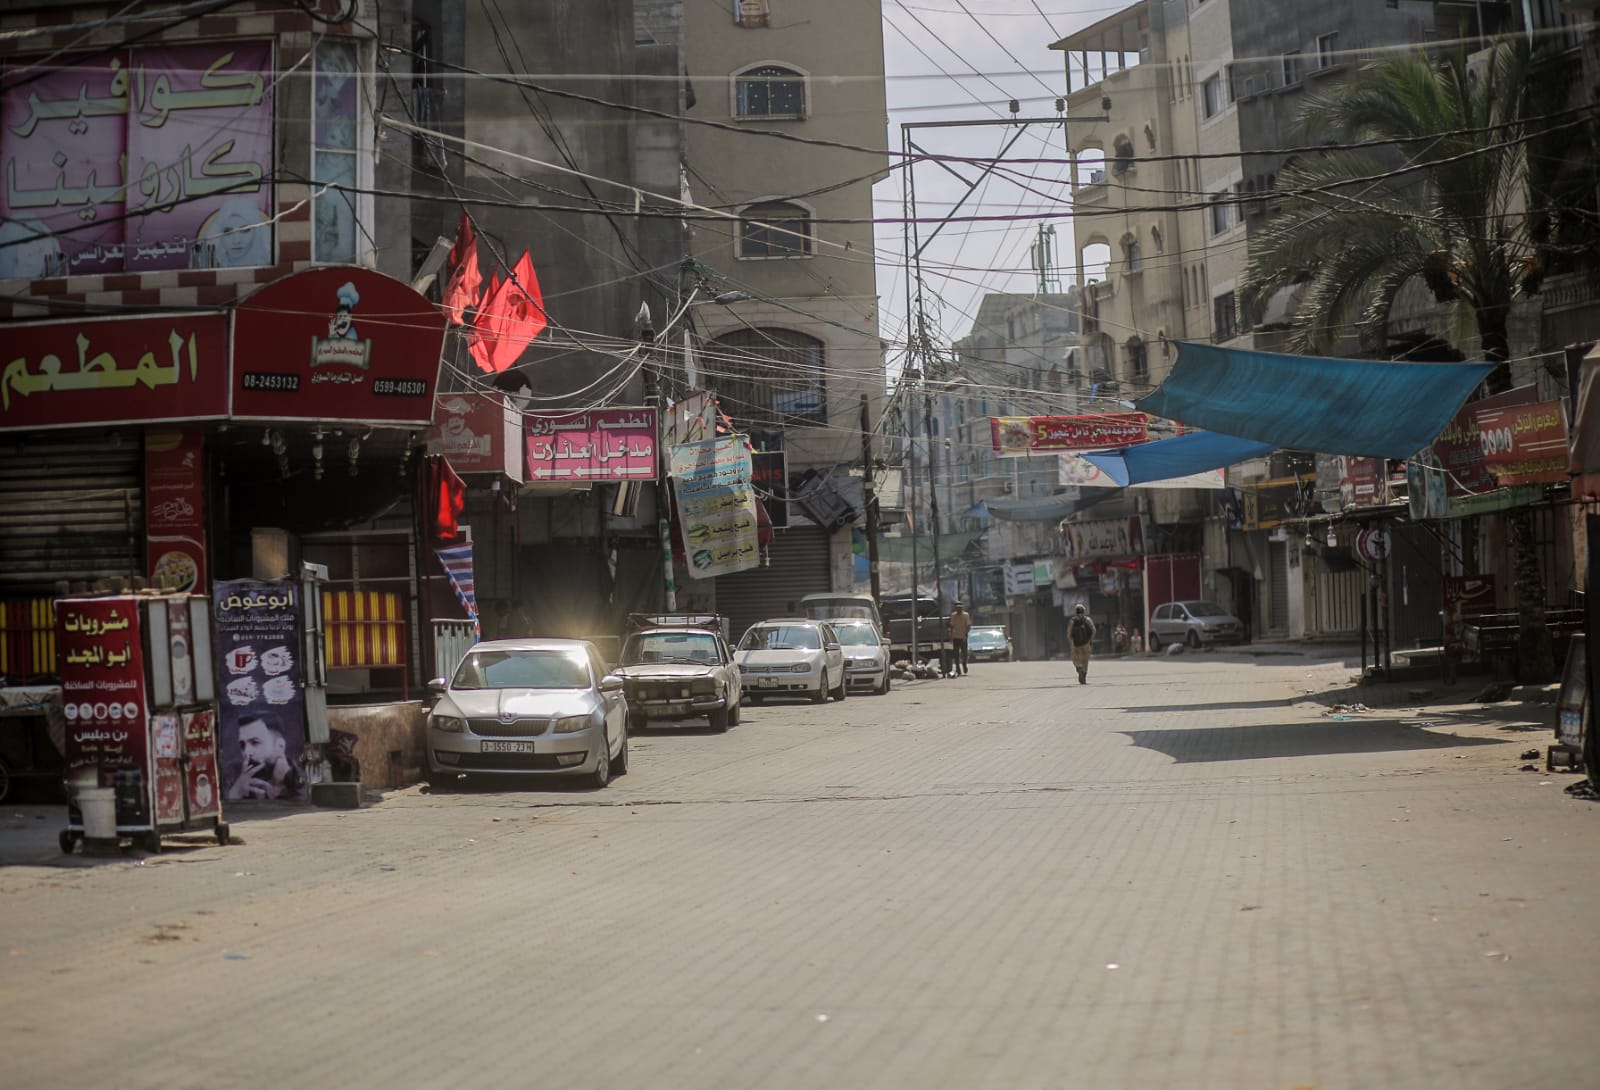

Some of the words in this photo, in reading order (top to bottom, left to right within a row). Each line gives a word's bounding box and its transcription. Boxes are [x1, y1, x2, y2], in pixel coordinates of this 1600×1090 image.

[8, 51, 265, 139] كوافير
[7, 139, 264, 221] كارولينا
[131, 235, 187, 261] لتجهيز
[1, 327, 198, 414] المطعم
[244, 374, 299, 390] 08-2453132
[531, 414, 592, 437] السوري
[596, 413, 652, 432] المطعم
[1037, 425, 1047, 440] 5
[532, 439, 597, 461] العائلات
[599, 439, 653, 462] مدخل
[64, 609, 129, 636] مشروبات
[67, 646, 104, 665] المجد
